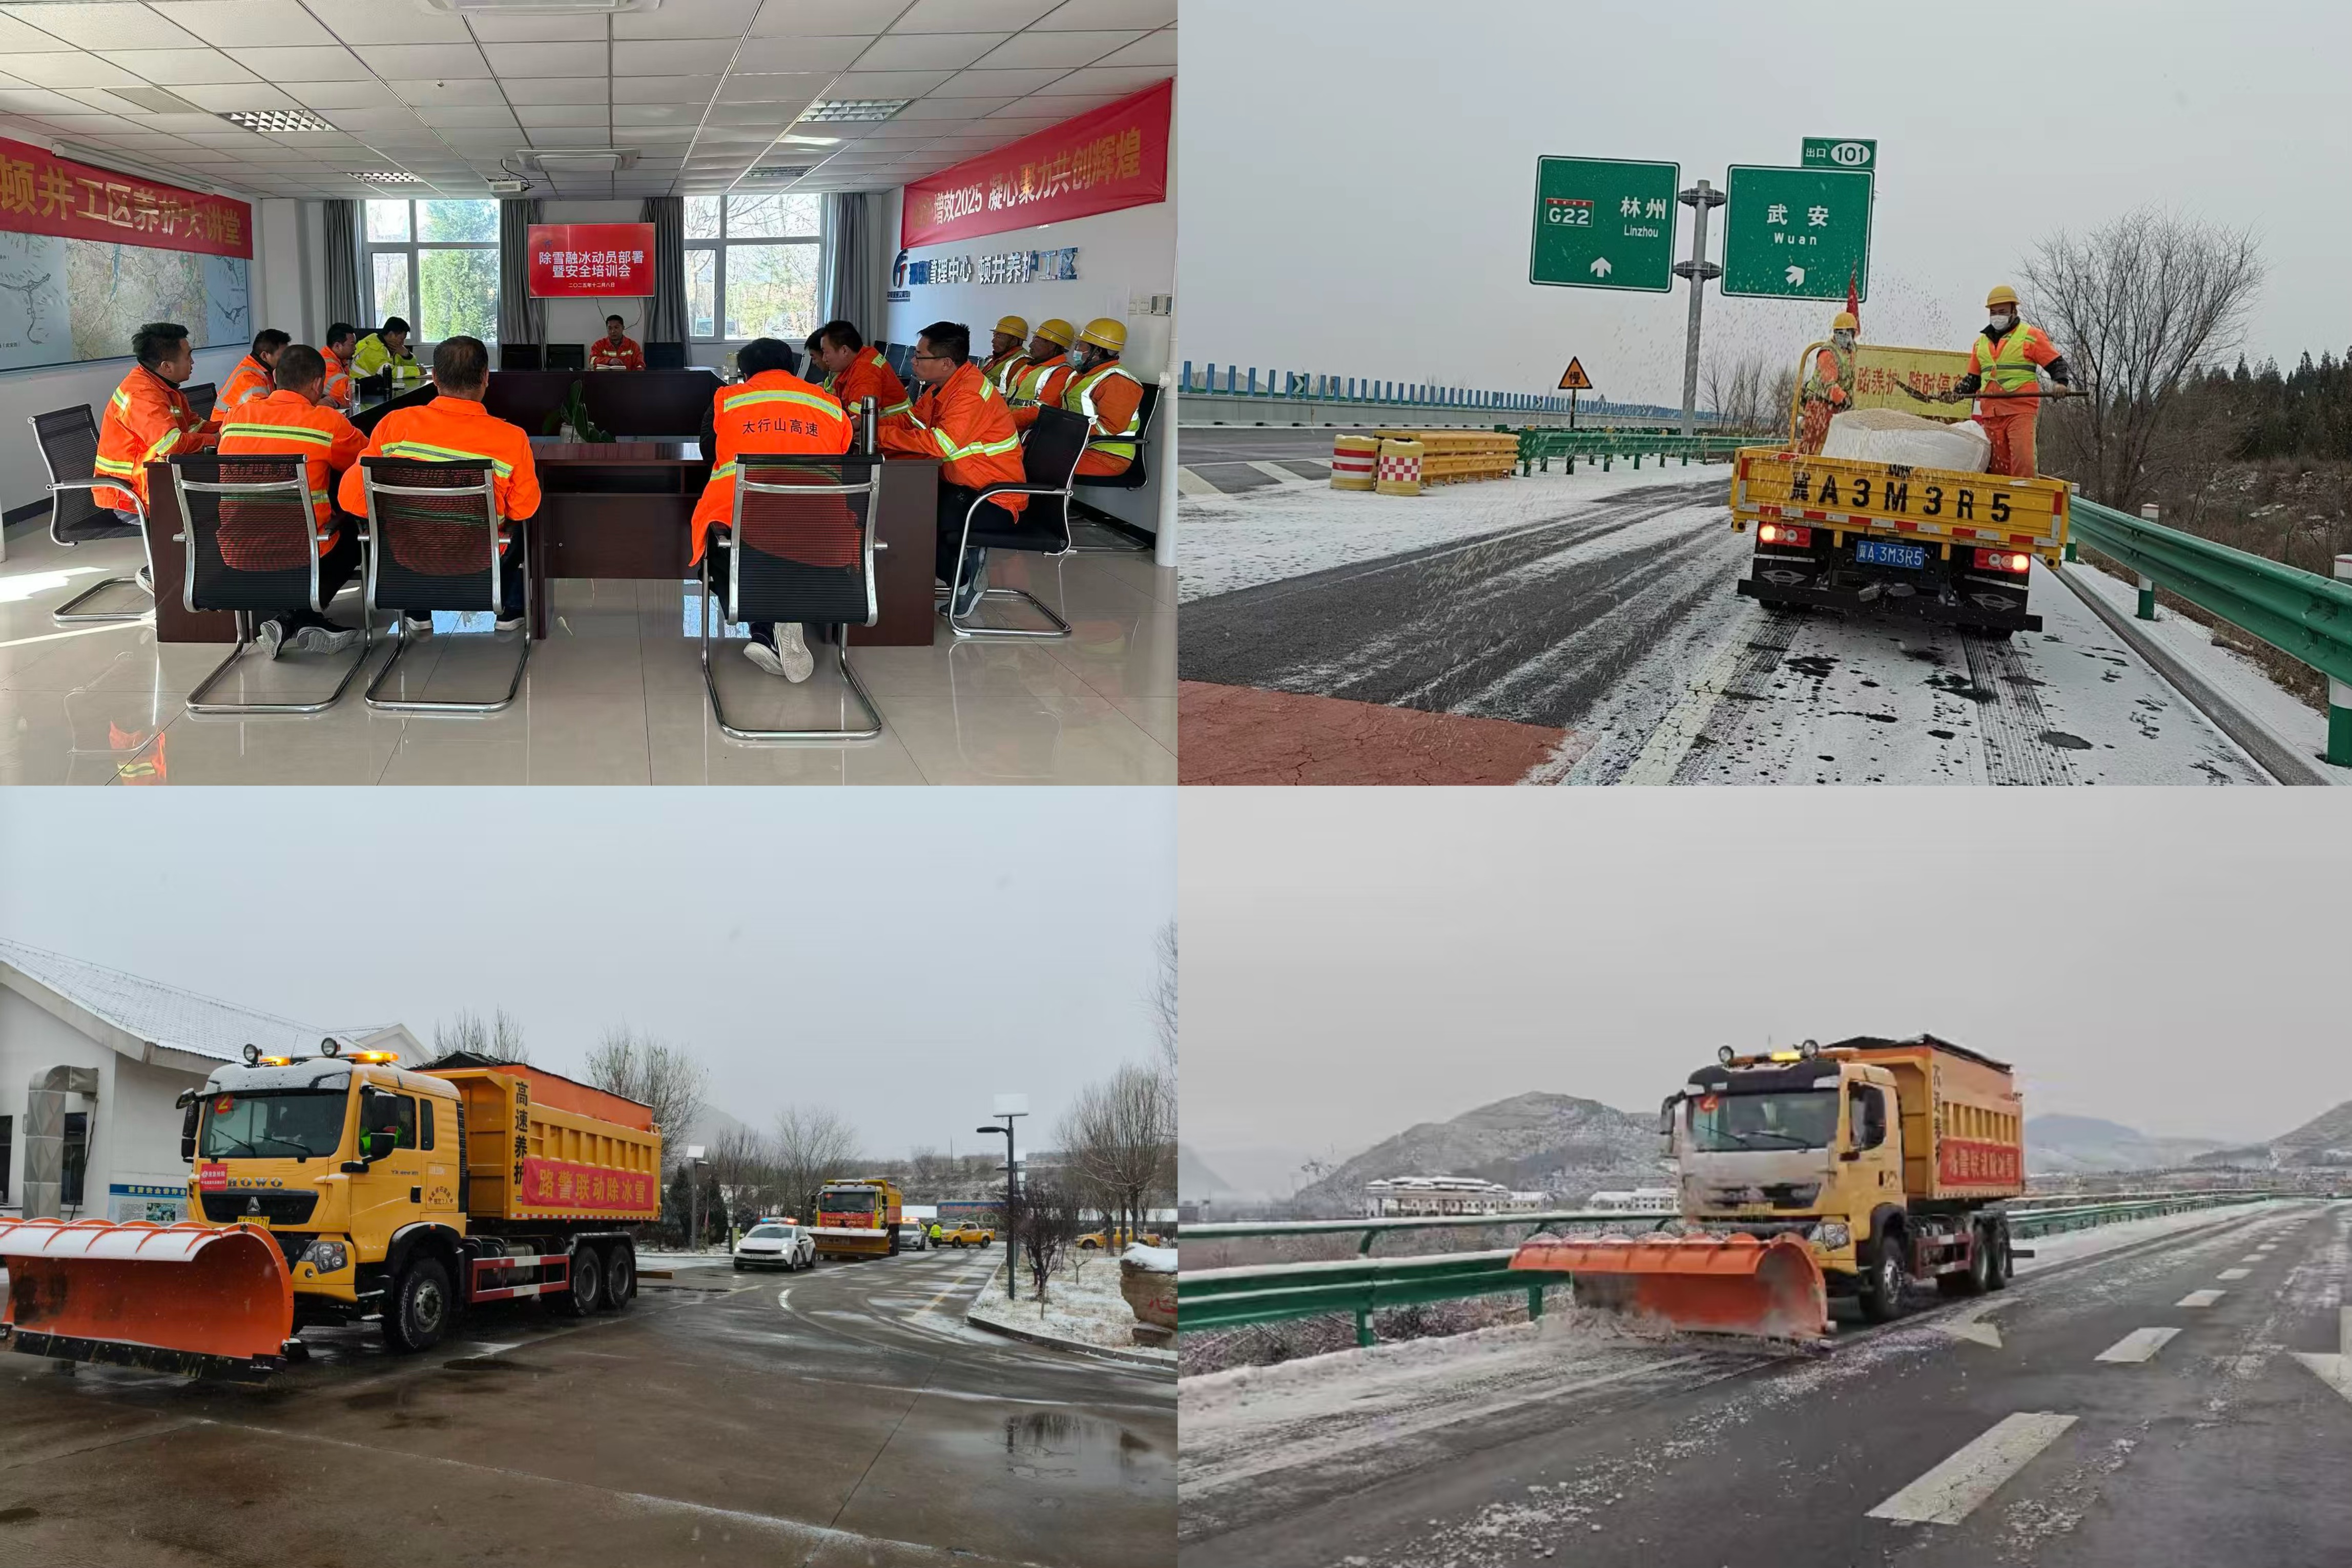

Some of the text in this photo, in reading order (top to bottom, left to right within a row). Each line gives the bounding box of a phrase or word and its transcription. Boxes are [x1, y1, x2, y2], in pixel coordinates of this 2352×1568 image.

[1806, 146, 1864, 162] 出口 101
[913, 126, 1142, 229] 增效2025 凝心聚力共创辉煌
[0, 155, 242, 246] 顿井工区养护大讲堂
[1620, 196, 1666, 220] 林州
[1549, 207, 1589, 224] G22
[1767, 204, 1829, 227] 武安
[1624, 224, 1658, 238] Linzhou
[1774, 233, 1817, 245] Wuan
[539, 251, 645, 265] 除雪融冰动员部署
[978, 247, 1078, 284] 顿井养护工区
[552, 265, 631, 278] 暨安全培训会
[1569, 371, 1581, 385] 慢
[742, 418, 819, 437] 太行山高速
[227, 1177, 283, 1187] HOWO
[539, 1168, 645, 1204] 路警联动除冰雪
